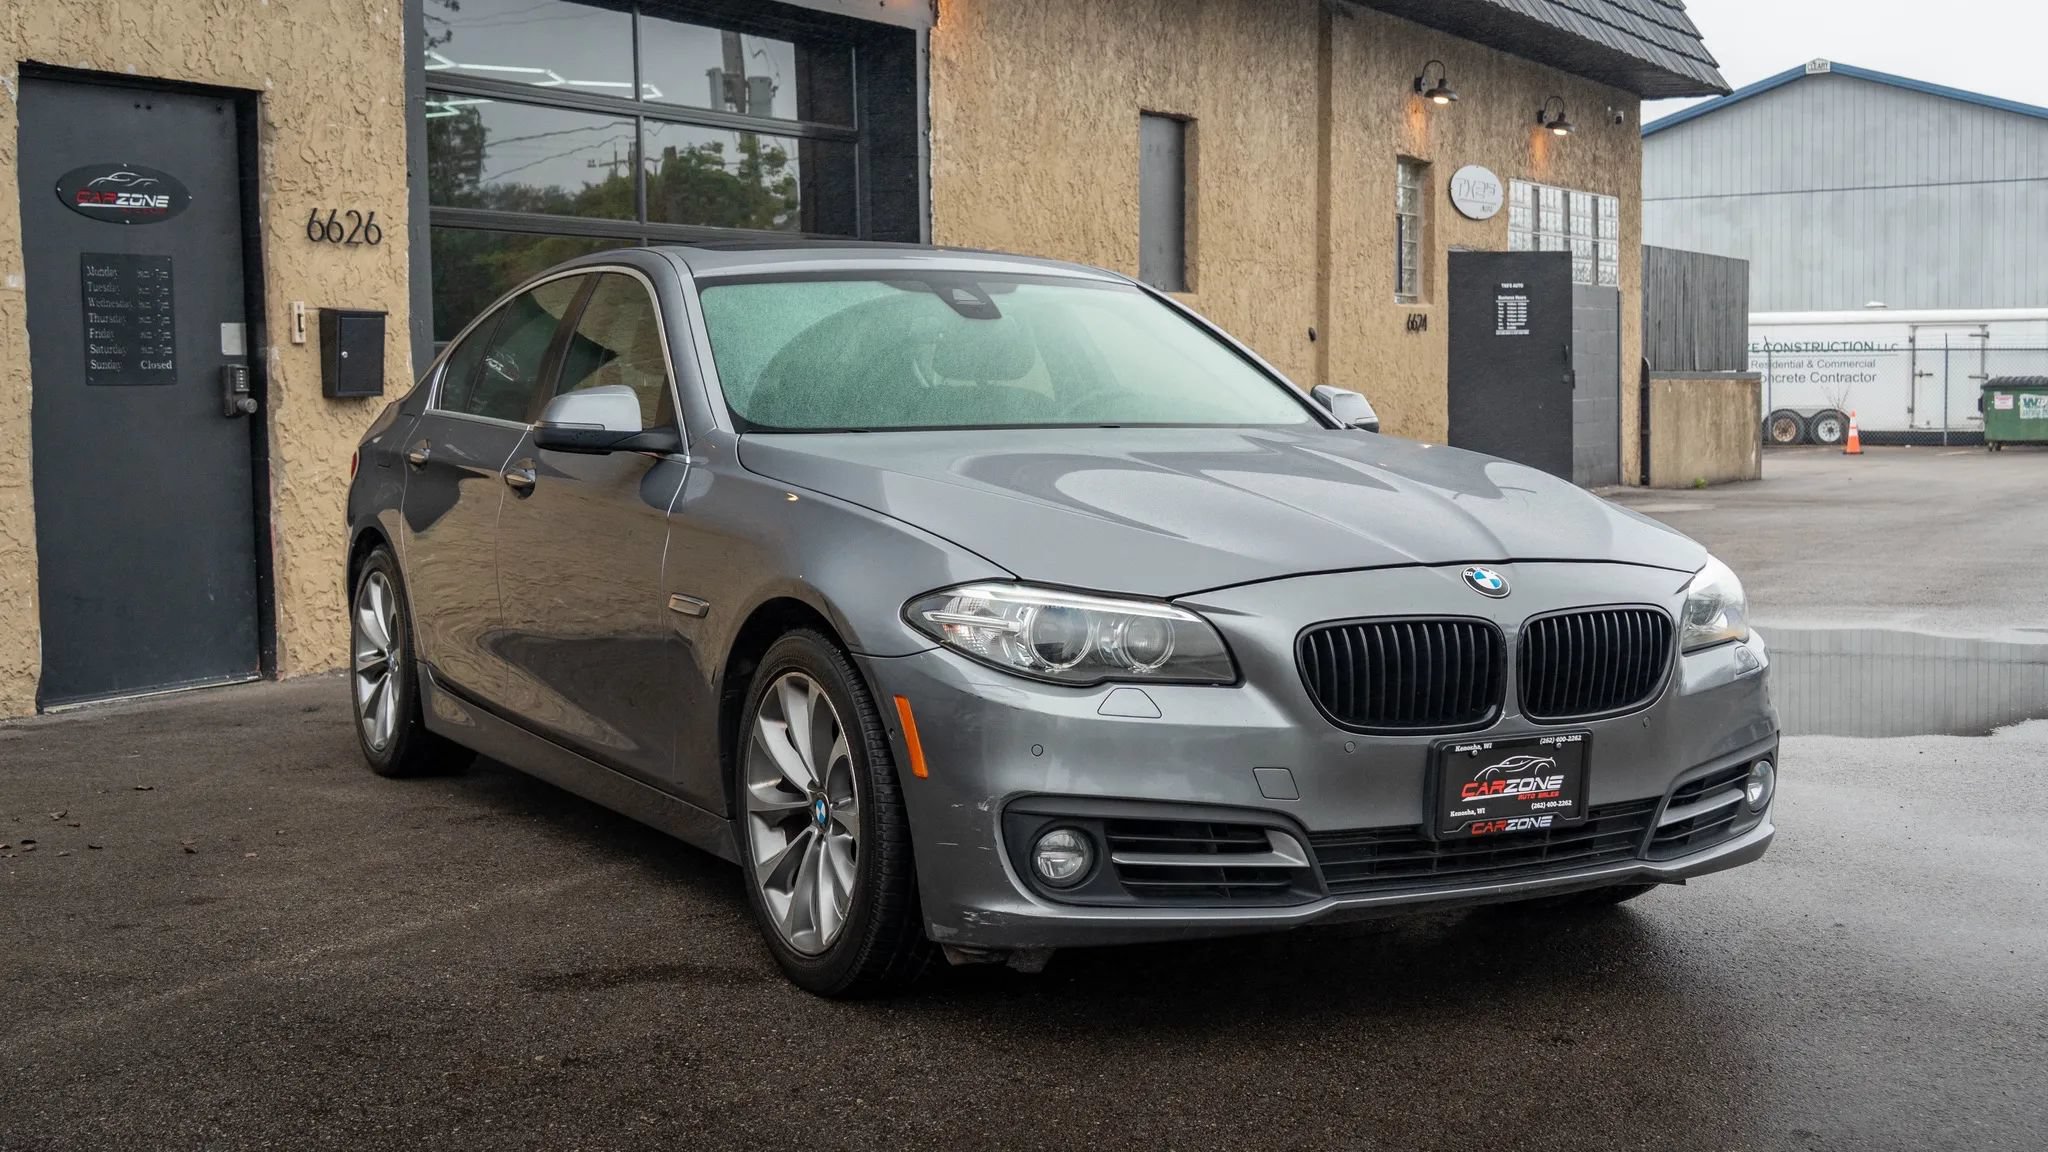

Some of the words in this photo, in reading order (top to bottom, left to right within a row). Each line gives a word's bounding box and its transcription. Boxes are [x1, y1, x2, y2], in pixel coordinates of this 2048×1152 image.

[76, 191, 170, 208] CARZONE
[307, 207, 382, 246] 6626
[86, 266, 118, 280] Monday
[87, 282, 121, 295] Tuesday
[88, 313, 127, 326] Thursday
[89, 328, 115, 342] Friday
[90, 344, 128, 356] Saturday
[1763, 341, 1874, 353] CONSTRUCTION
[1877, 343, 1899, 352] LLC
[90, 360, 122, 373] Sunday
[140, 360, 173, 370] Closed
[1751, 359, 1804, 369] Resdential
[1807, 359, 1814, 369] &
[1817, 359, 1876, 369] Commercial
[1760, 372, 1806, 383] oncrete
[1810, 371, 1877, 383] Contractor
[1460, 774, 1565, 798] CARZONE
[1517, 793, 1536, 801] AUTO
[1537, 790, 1560, 799] SALES
[1450, 808, 1477, 818] Kenosha,
[1471, 815, 1553, 836] CARZONE
